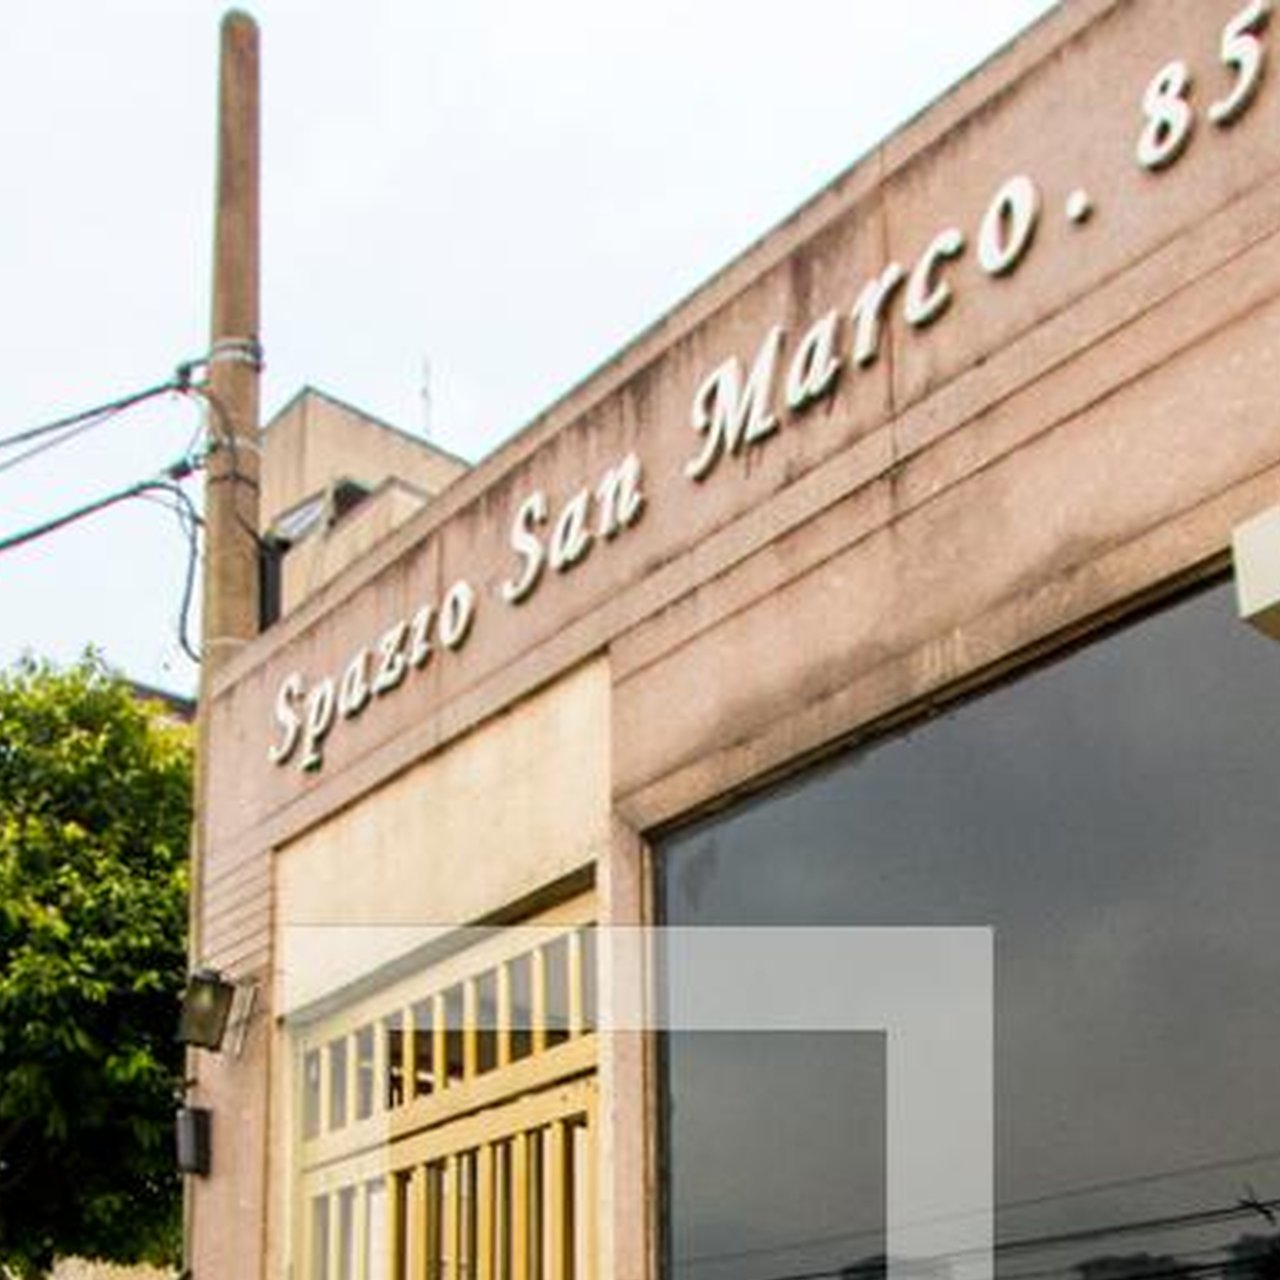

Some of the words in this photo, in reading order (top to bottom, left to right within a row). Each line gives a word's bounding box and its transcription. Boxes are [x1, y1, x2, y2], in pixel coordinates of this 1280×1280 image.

[268, 577, 477, 769] Spazio
[502, 451, 646, 604] San
[1135, 0, 1270, 168] 85
